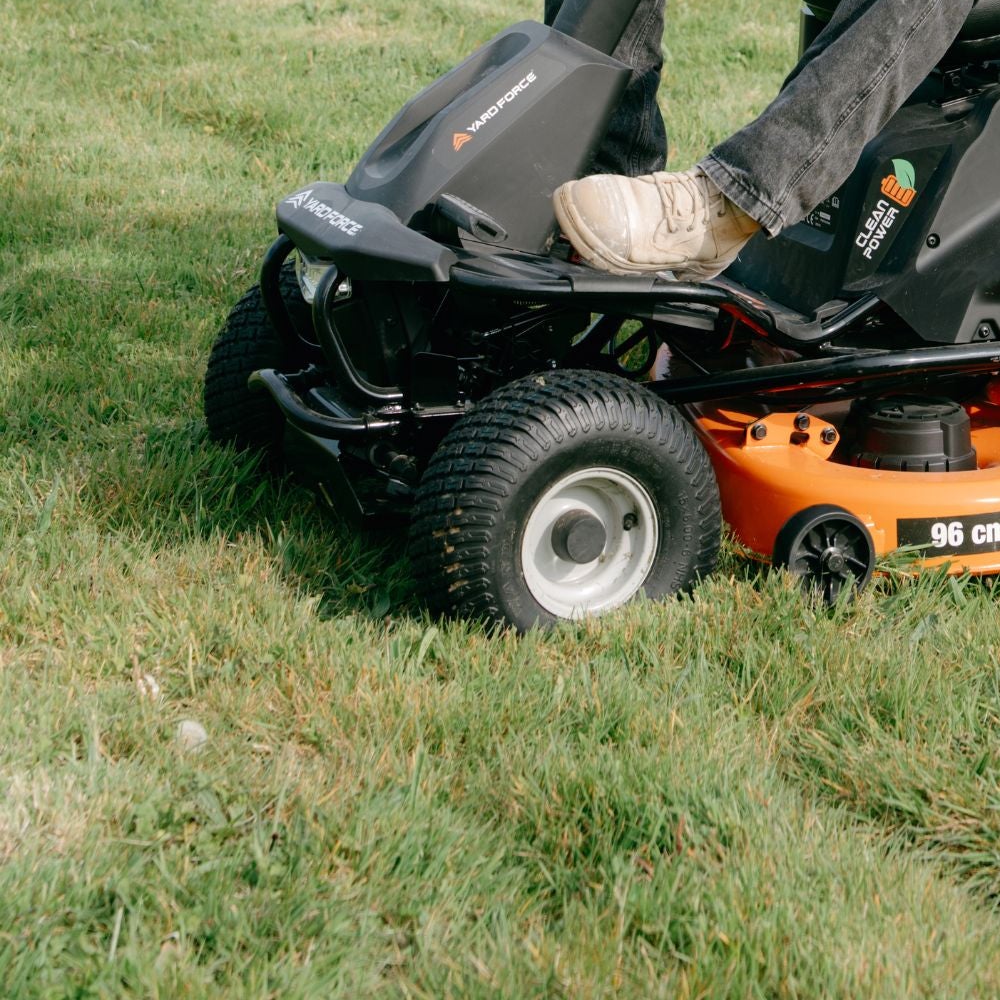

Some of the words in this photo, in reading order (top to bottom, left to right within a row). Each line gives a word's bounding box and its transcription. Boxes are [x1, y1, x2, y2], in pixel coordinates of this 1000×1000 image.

[466, 105, 499, 133] YARD
[496, 70, 537, 109] FORCE
[303, 197, 333, 218] YARD
[322, 210, 363, 236] FORCE
[855, 199, 890, 248] CLEAN
[862, 207, 900, 260] POWER
[931, 521, 964, 548] 96
